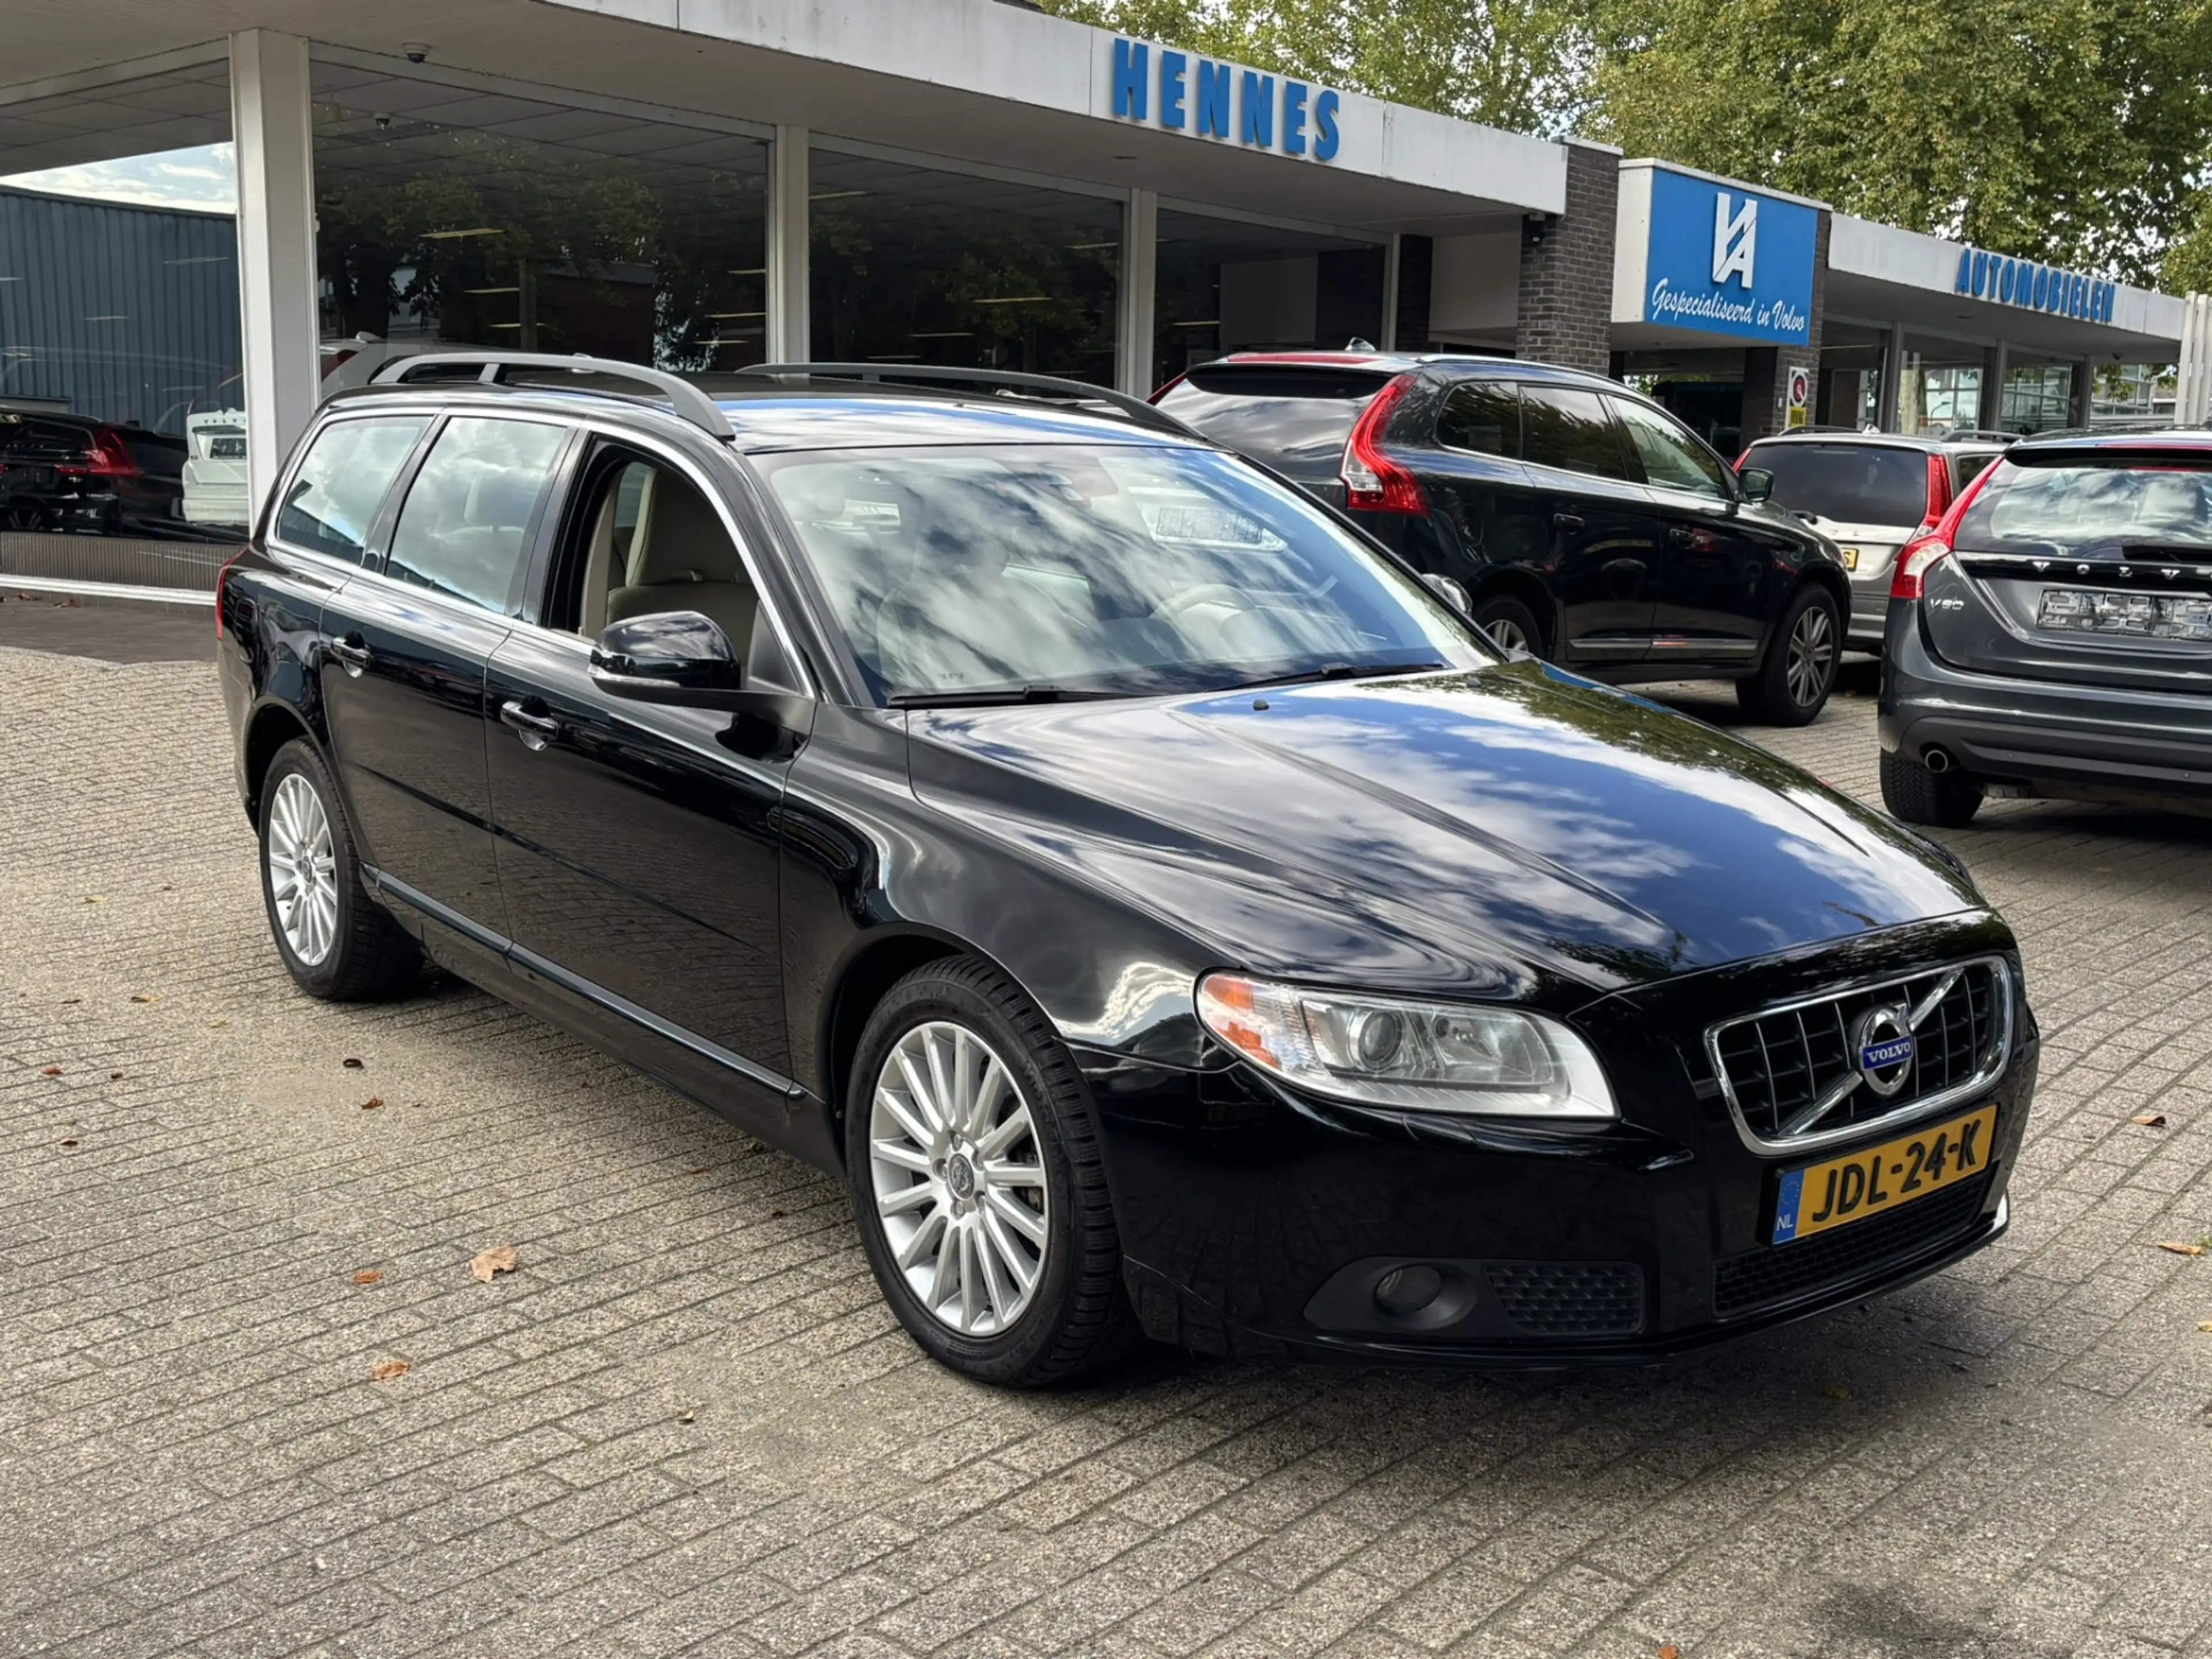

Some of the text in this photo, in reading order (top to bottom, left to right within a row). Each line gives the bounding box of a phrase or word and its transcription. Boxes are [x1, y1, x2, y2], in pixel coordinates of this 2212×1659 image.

[1112, 38, 1339, 161] HENNES
[1652, 277, 1805, 332] Gespecialiseerd in Volvo
[1955, 248, 2115, 323] AUTOMOBIELEN
[2032, 561, 2212, 581] VOLV
[1866, 1041, 1911, 1063] VOLVO
[1812, 1118, 1981, 1222] JDL-24-K
[1777, 1215, 1794, 1232] NL
